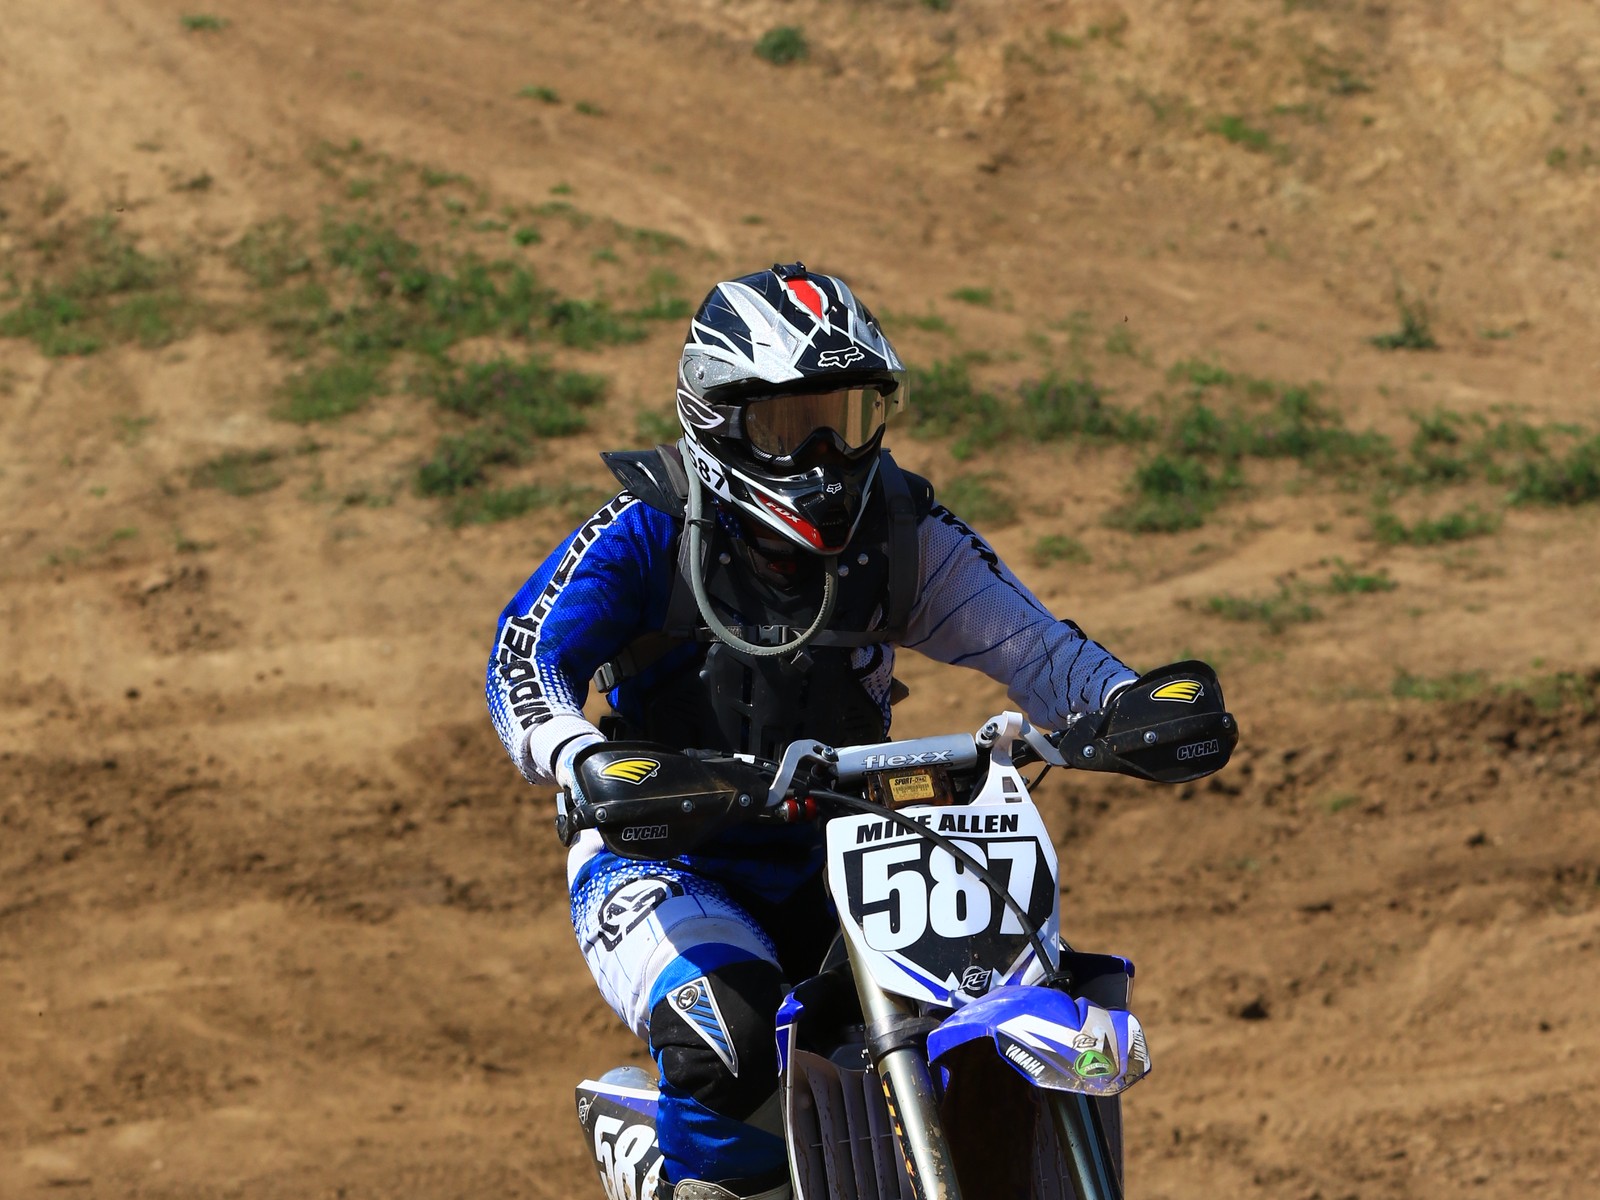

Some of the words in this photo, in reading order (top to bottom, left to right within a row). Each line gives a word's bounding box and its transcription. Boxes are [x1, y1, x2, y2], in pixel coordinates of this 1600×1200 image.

[765, 501, 801, 523] FOX
[863, 749, 953, 770] flexx
[1176, 738, 1220, 761] CYCRA
[621, 824, 669, 842] CYCRA
[938, 814, 1019, 834] ALLEN
[862, 839, 1038, 952] 587
[1005, 1043, 1046, 1077] YAMAHA
